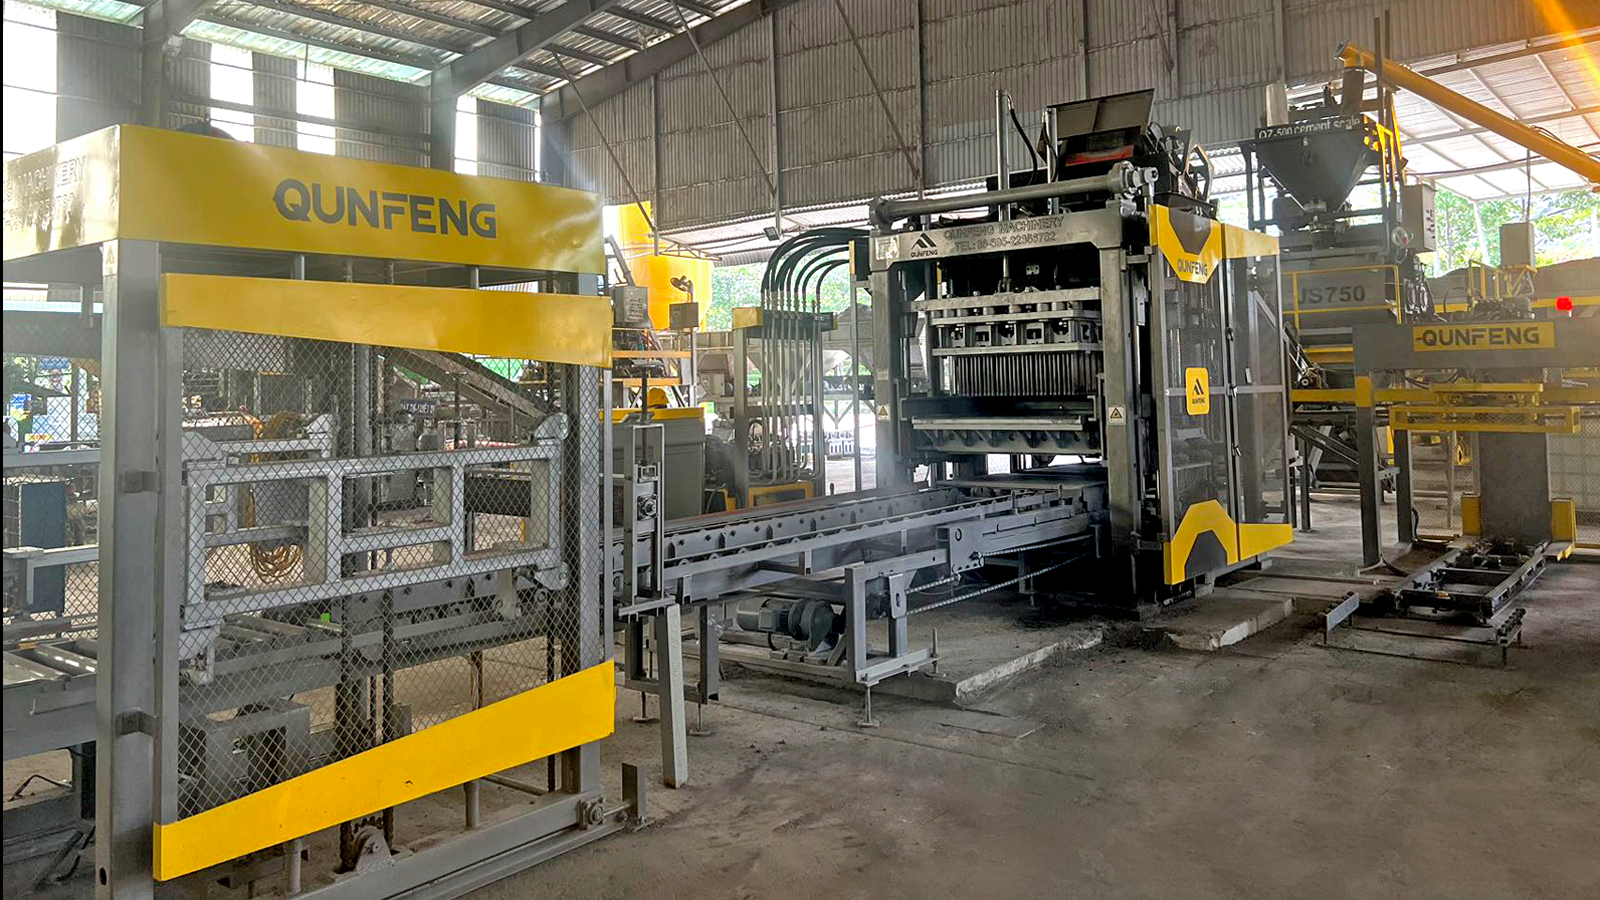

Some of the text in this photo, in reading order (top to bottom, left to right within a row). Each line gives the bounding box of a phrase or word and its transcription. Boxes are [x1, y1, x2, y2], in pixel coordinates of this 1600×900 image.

[273, 178, 497, 239] QUNFENG
[944, 216, 1064, 241] QUNFENG MACHINERY
[910, 249, 938, 258] QUNFENG
[1178, 259, 1208, 277] QUNFENG
[1298, 285, 1366, 304] JS750
[1420, 326, 1540, 347] QUNFENG
